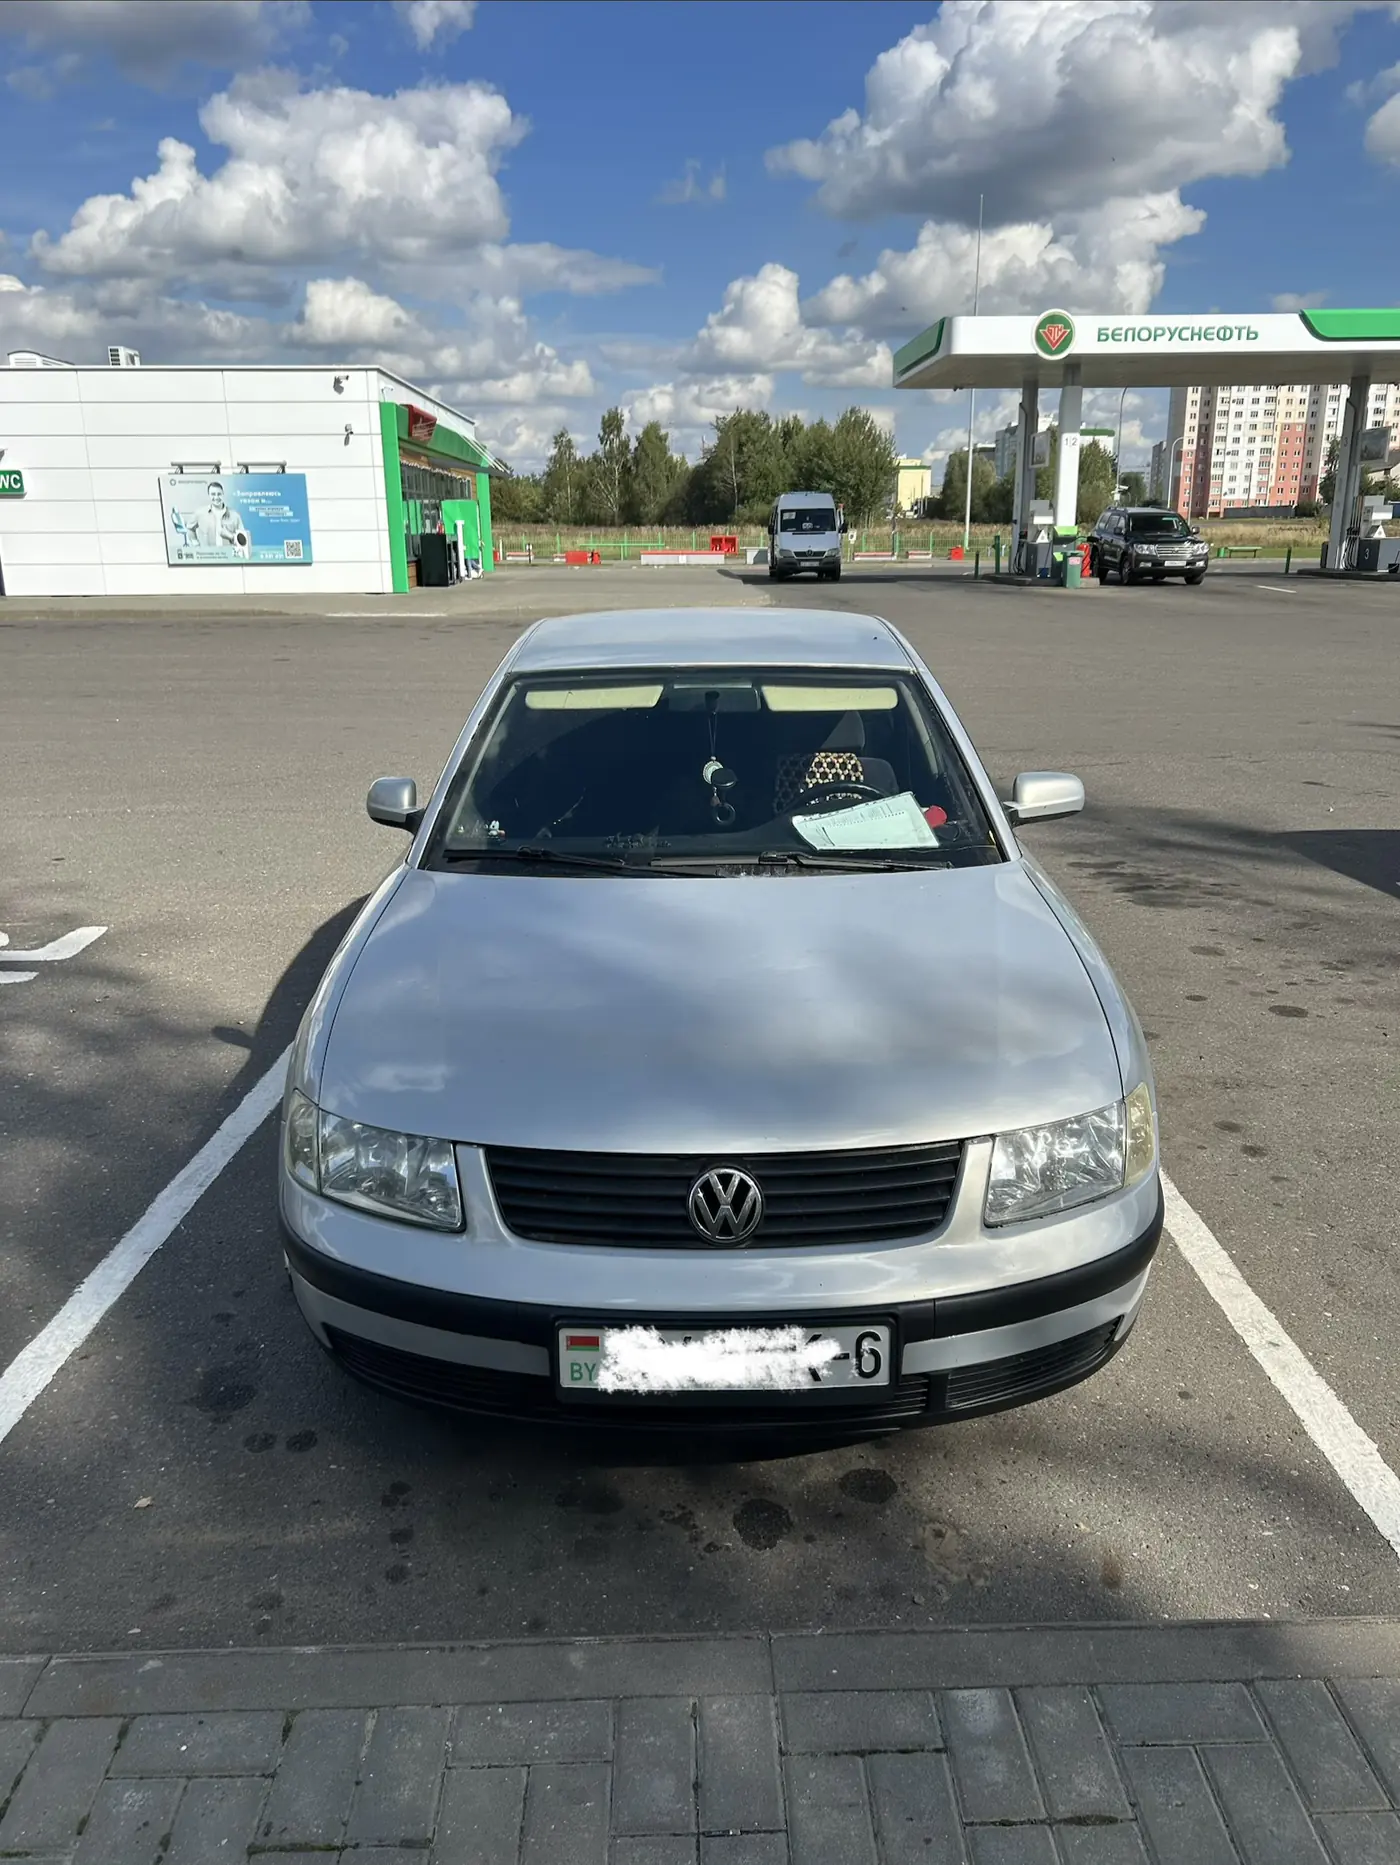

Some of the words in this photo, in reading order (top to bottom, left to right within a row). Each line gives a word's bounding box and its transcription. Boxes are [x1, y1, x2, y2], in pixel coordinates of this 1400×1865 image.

[1096, 325, 1259, 343] БЕЛОРУСНЕФТЬ
[1364, 547, 1370, 560] 3
[570, 1362, 597, 1381] BY
